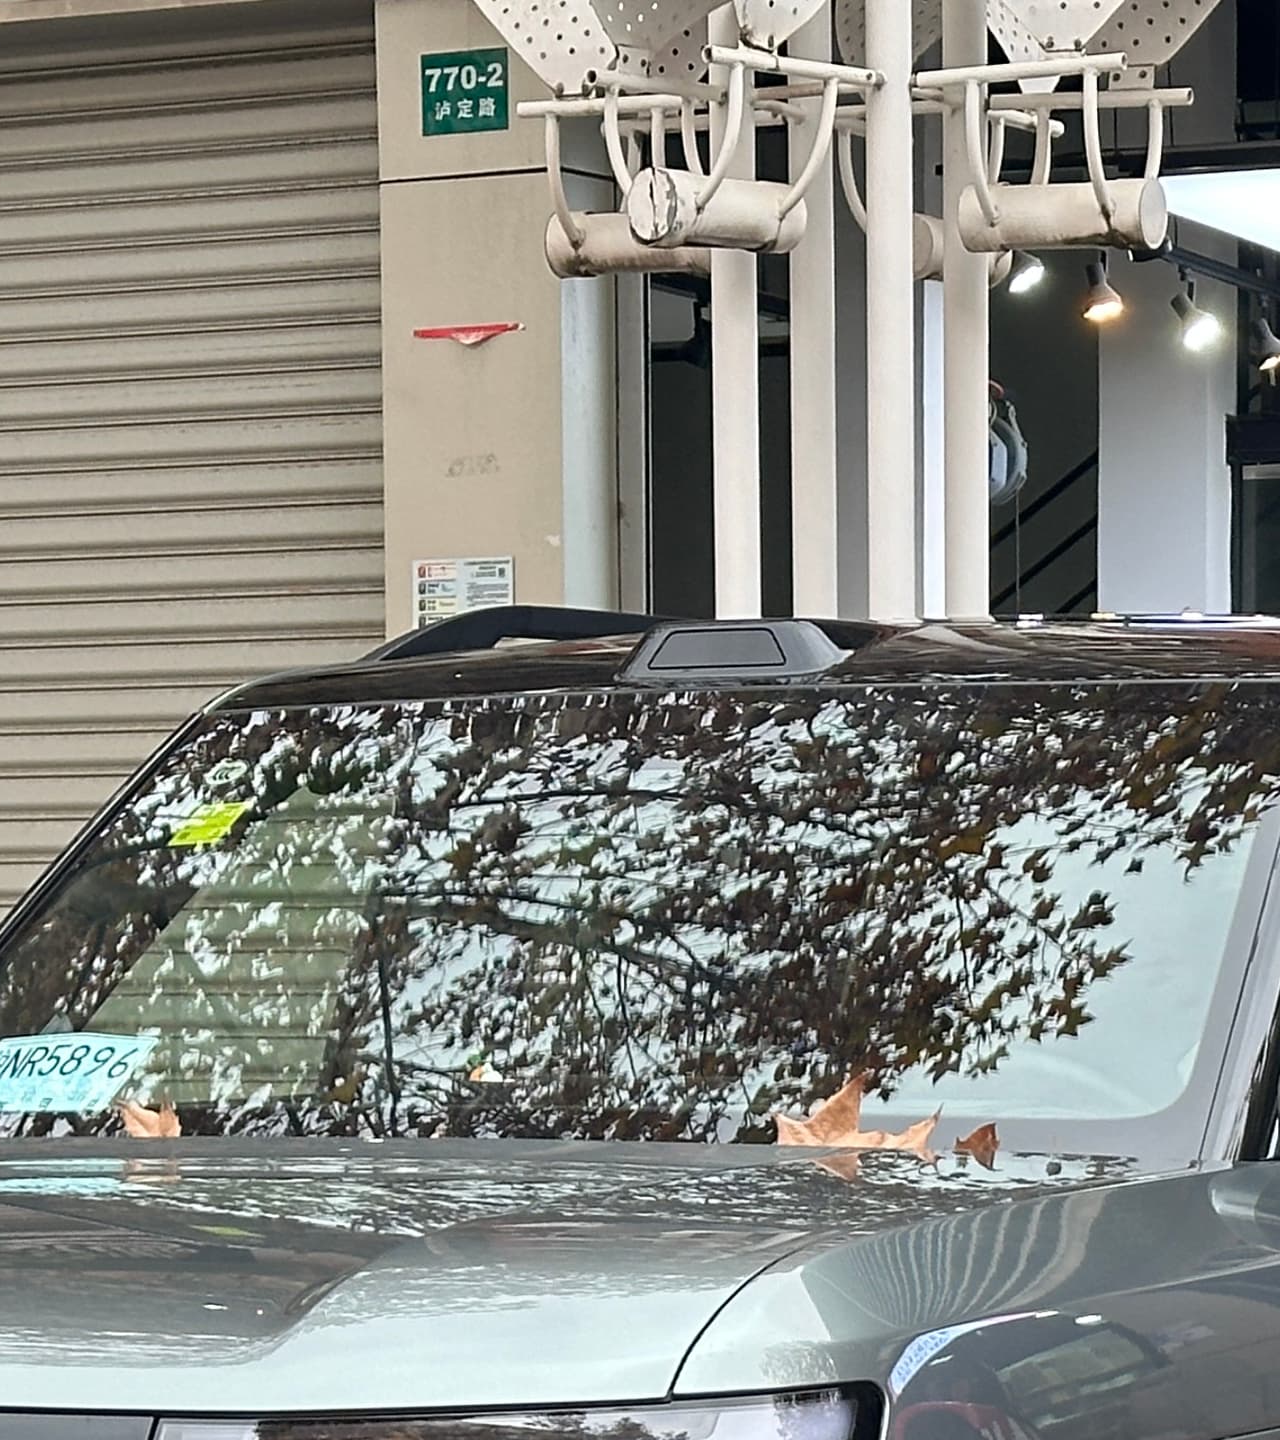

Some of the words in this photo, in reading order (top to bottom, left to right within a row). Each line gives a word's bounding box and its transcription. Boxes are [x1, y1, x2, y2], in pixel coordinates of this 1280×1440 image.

[424, 62, 504, 93] 770-2
[435, 97, 496, 121] 泸定路
